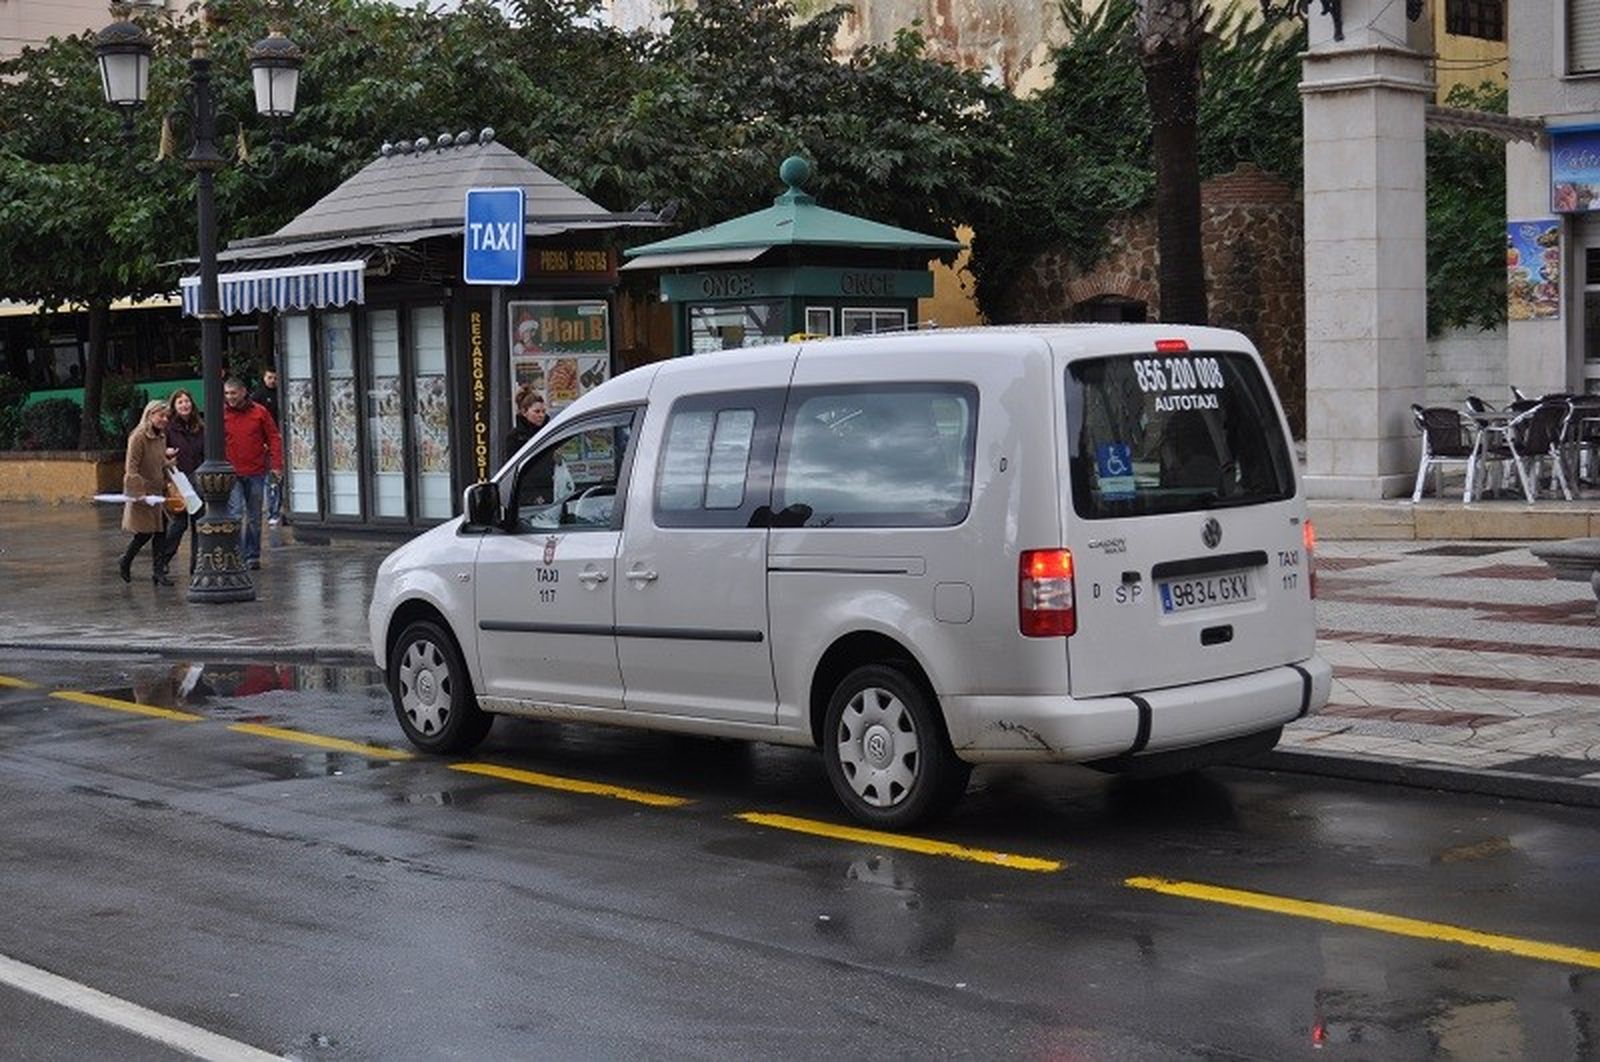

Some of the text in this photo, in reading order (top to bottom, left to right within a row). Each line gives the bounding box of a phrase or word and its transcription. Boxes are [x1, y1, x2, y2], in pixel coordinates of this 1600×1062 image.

[470, 222, 516, 250] TAXI
[702, 272, 754, 298] ONCE
[840, 272, 896, 296] ONCE
[541, 314, 604, 343] Plan B
[471, 311, 485, 402] RECARGAS
[1133, 357, 1225, 393] 856 200 008
[1155, 393, 1219, 413] AUTOTAXI
[1278, 550, 1299, 567] TAXI
[536, 567, 559, 583] TAXI
[1283, 573, 1298, 590] 117
[539, 589, 556, 603] 117
[1173, 575, 1248, 607] 9834 GXV
